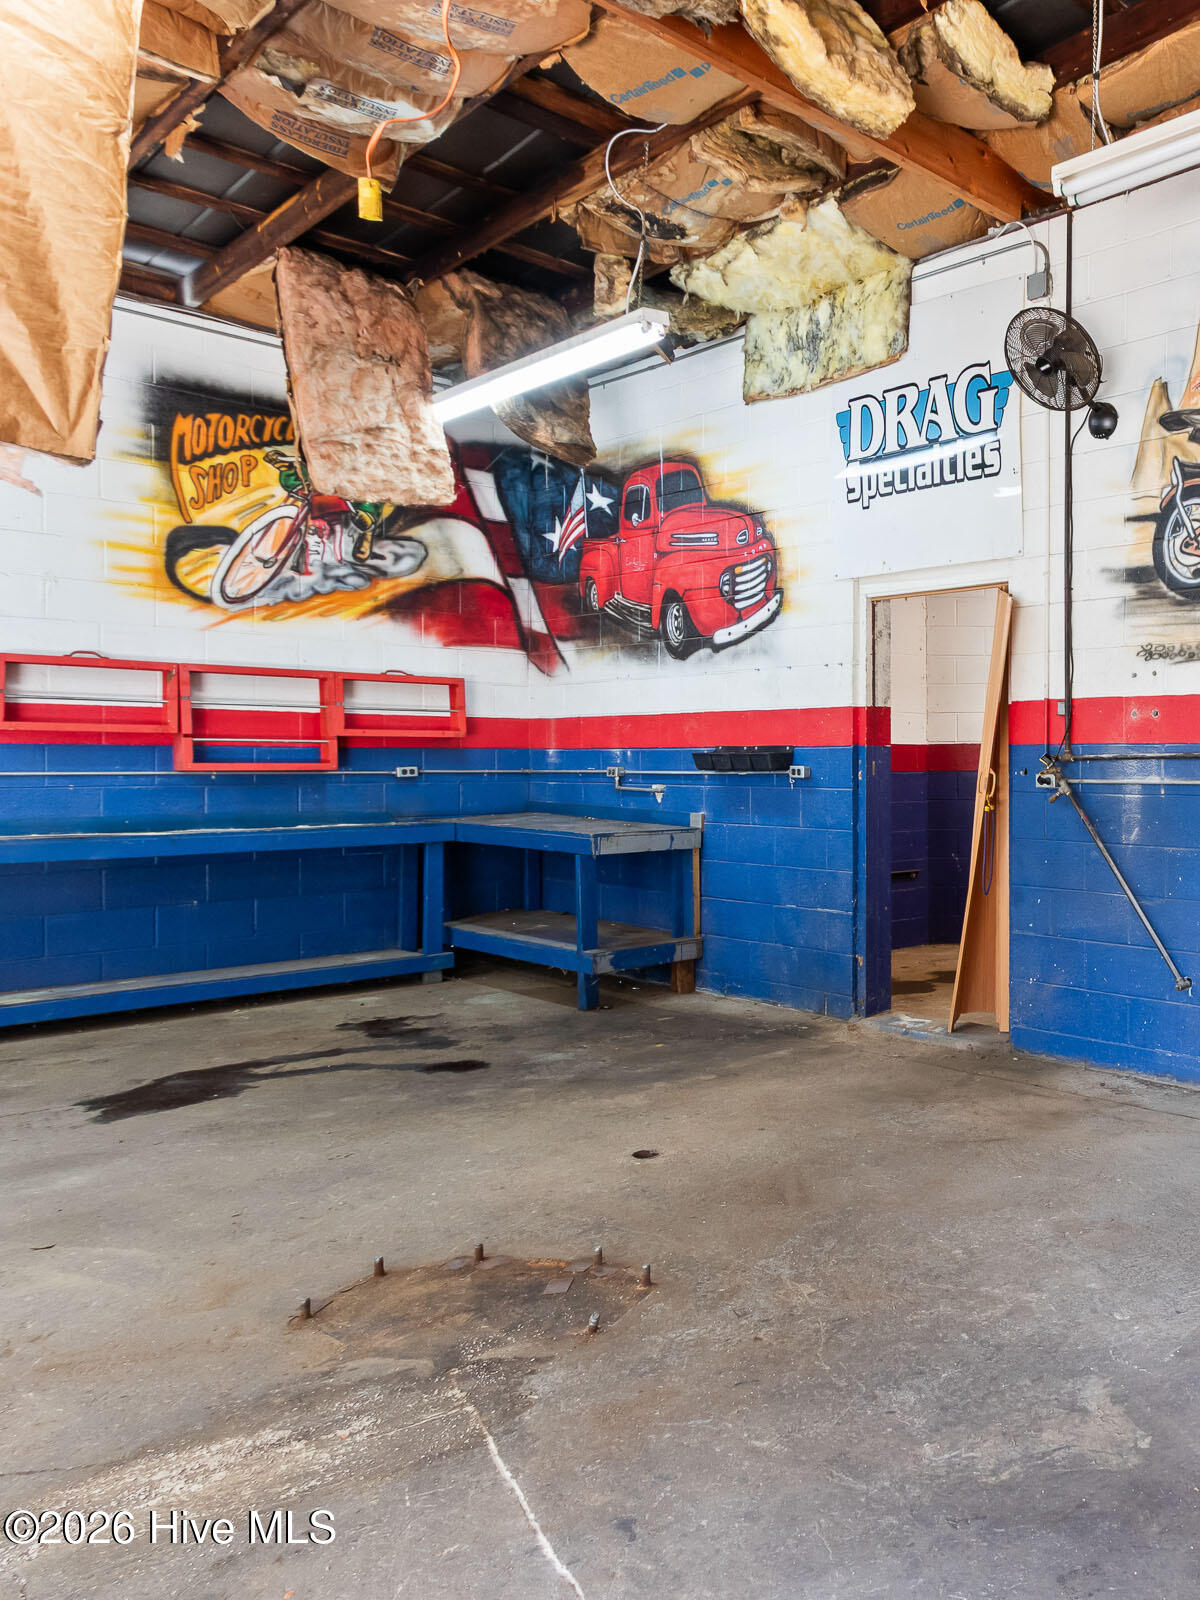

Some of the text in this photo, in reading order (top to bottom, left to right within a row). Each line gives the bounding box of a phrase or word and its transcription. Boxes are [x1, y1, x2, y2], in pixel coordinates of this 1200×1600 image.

[896, 204, 956, 231] CertainTeed
[848, 360, 999, 461] DRAG
[189, 454, 259, 510] SHOP
[846, 438, 1001, 510] Specialties
